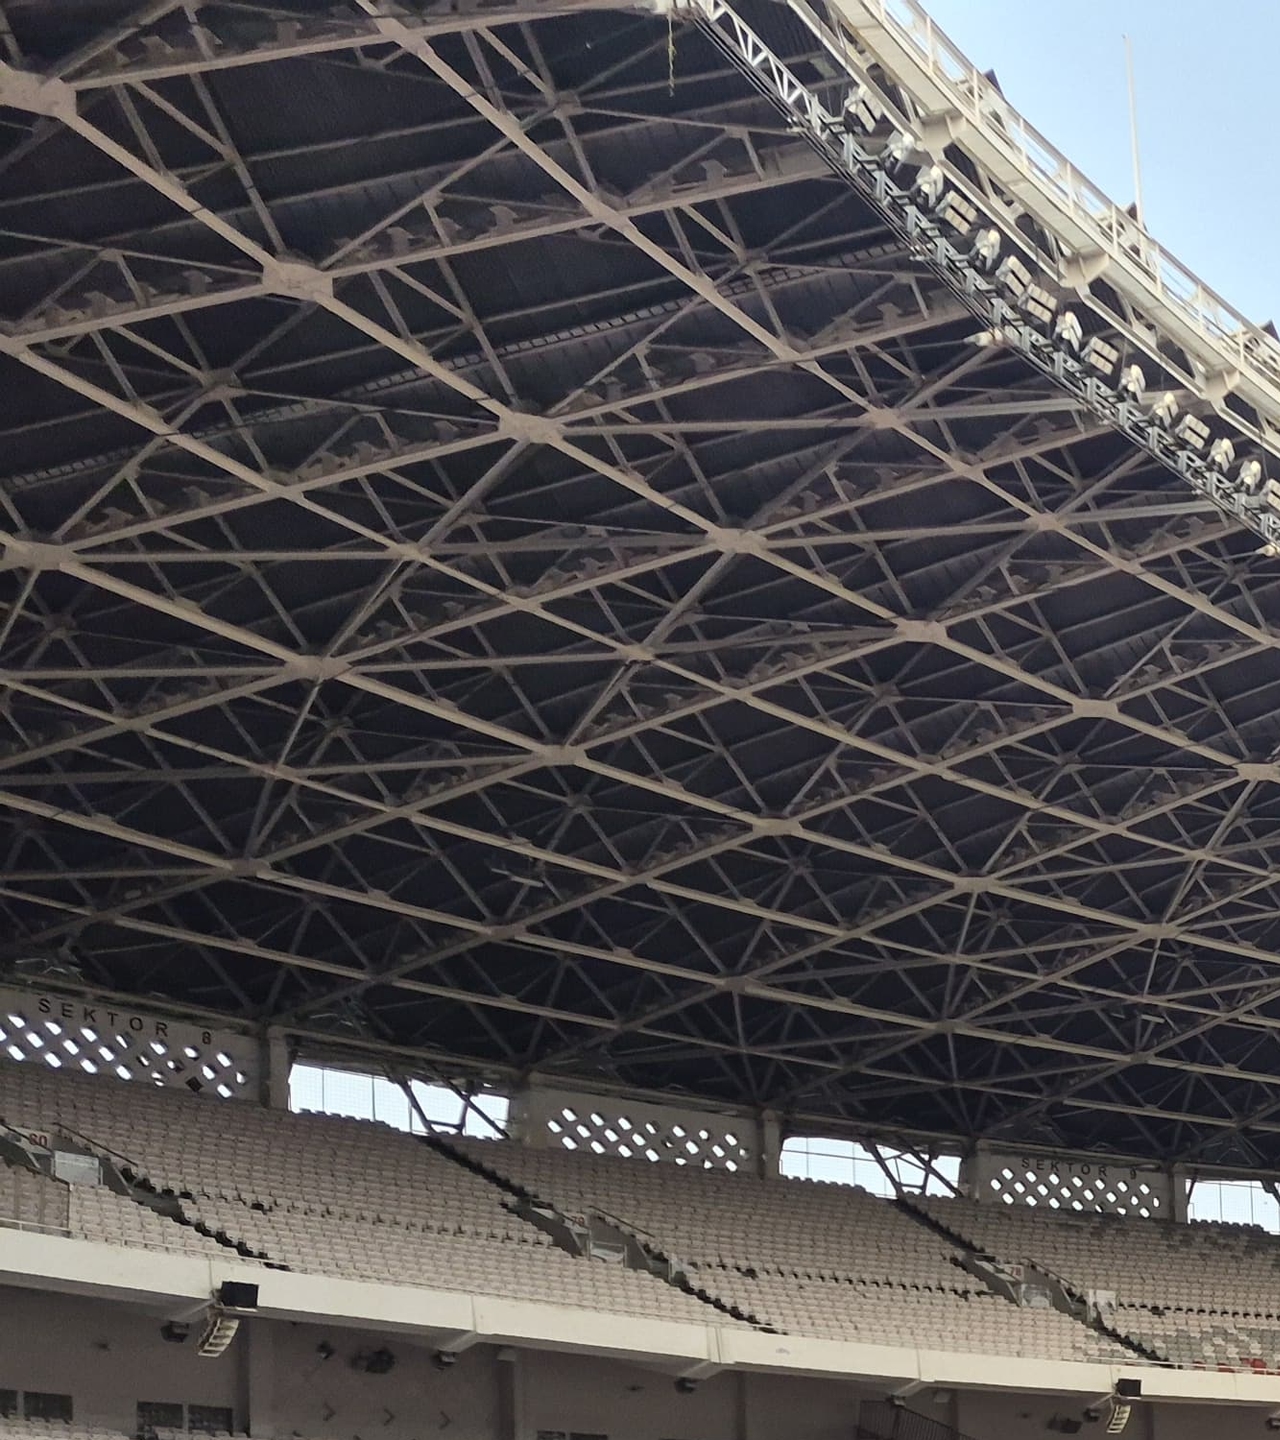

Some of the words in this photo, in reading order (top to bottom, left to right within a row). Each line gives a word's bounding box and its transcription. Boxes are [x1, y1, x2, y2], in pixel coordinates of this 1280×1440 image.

[38, 997, 168, 1037] SEKTOR
[201, 1031, 213, 1045] 8
[1021, 1158, 1107, 1177] SEKTOR
[1129, 1168, 1137, 1180] 9
